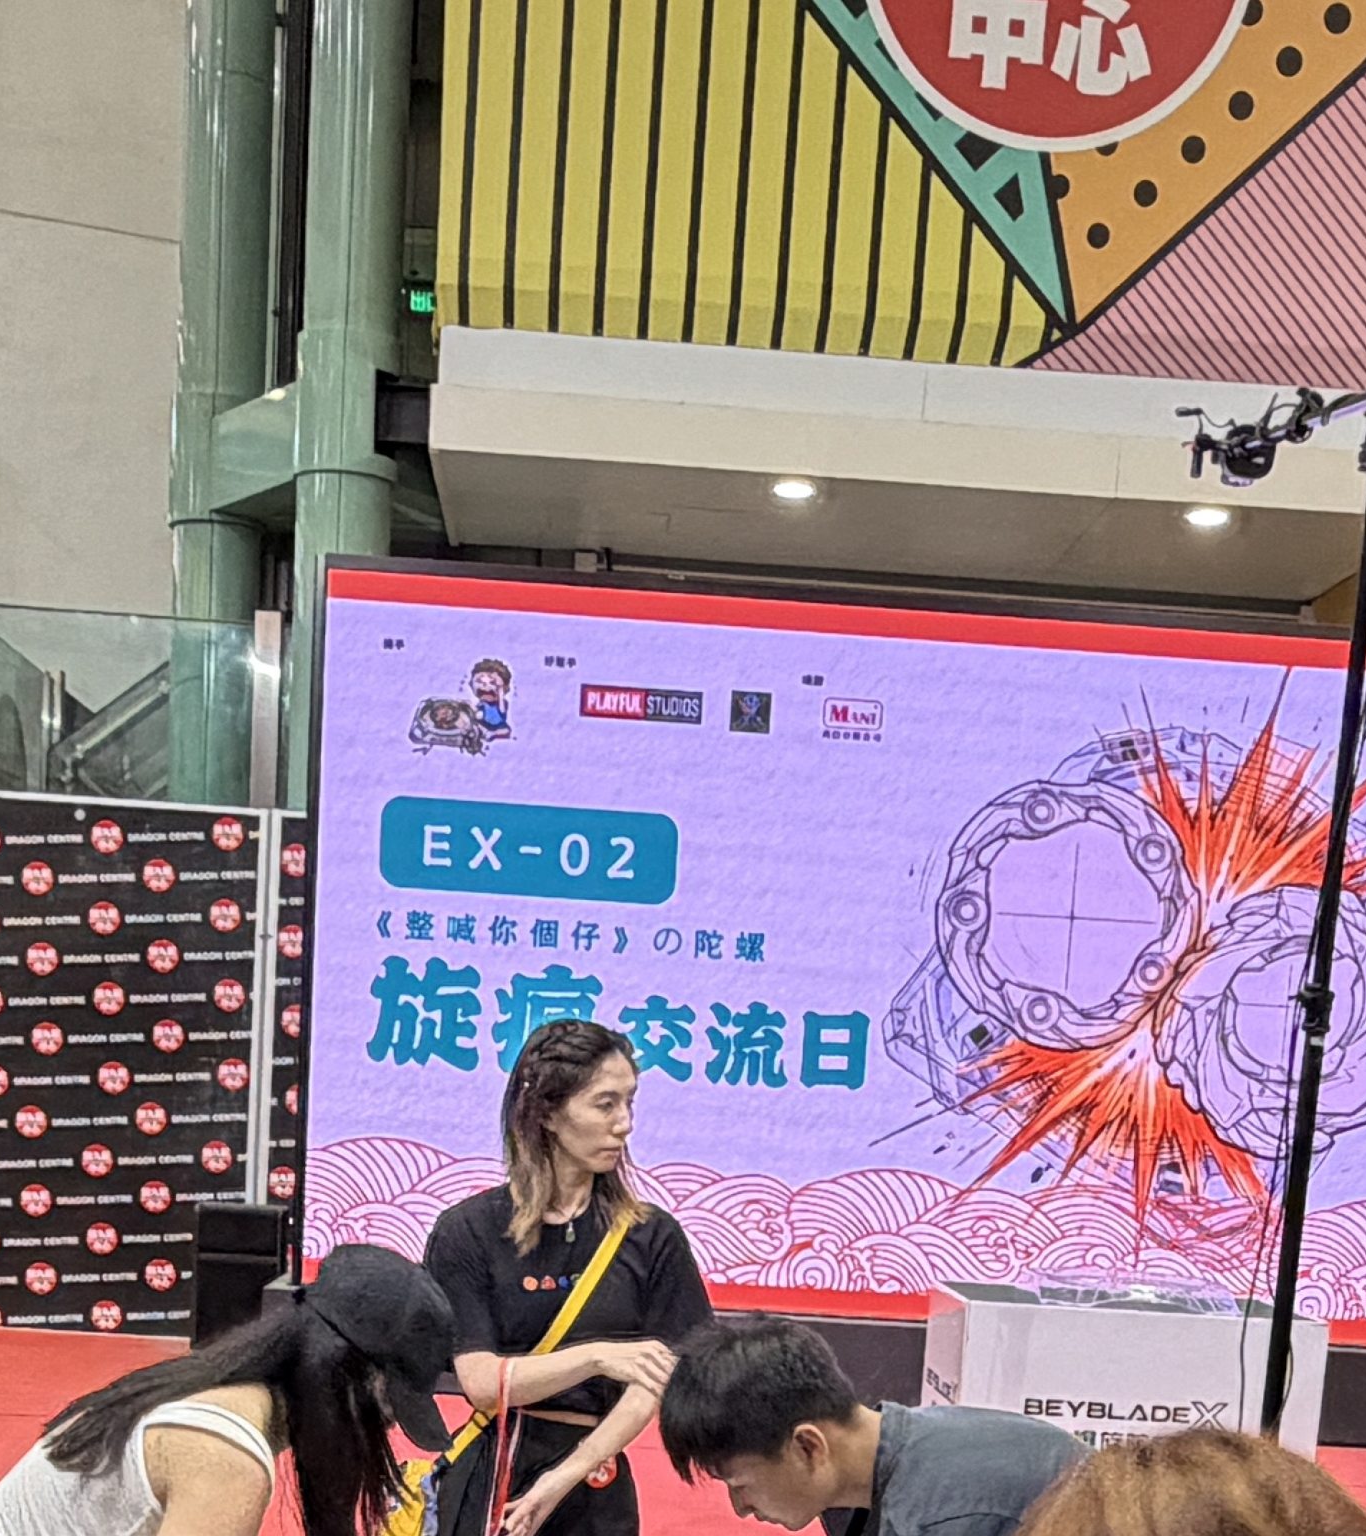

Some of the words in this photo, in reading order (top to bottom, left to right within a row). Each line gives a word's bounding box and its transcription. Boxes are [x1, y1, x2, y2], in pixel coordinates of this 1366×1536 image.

[586, 689, 643, 715] PLAYFUL
[646, 694, 701, 719] STUDIOS
[421, 824, 636, 880] EX-02
